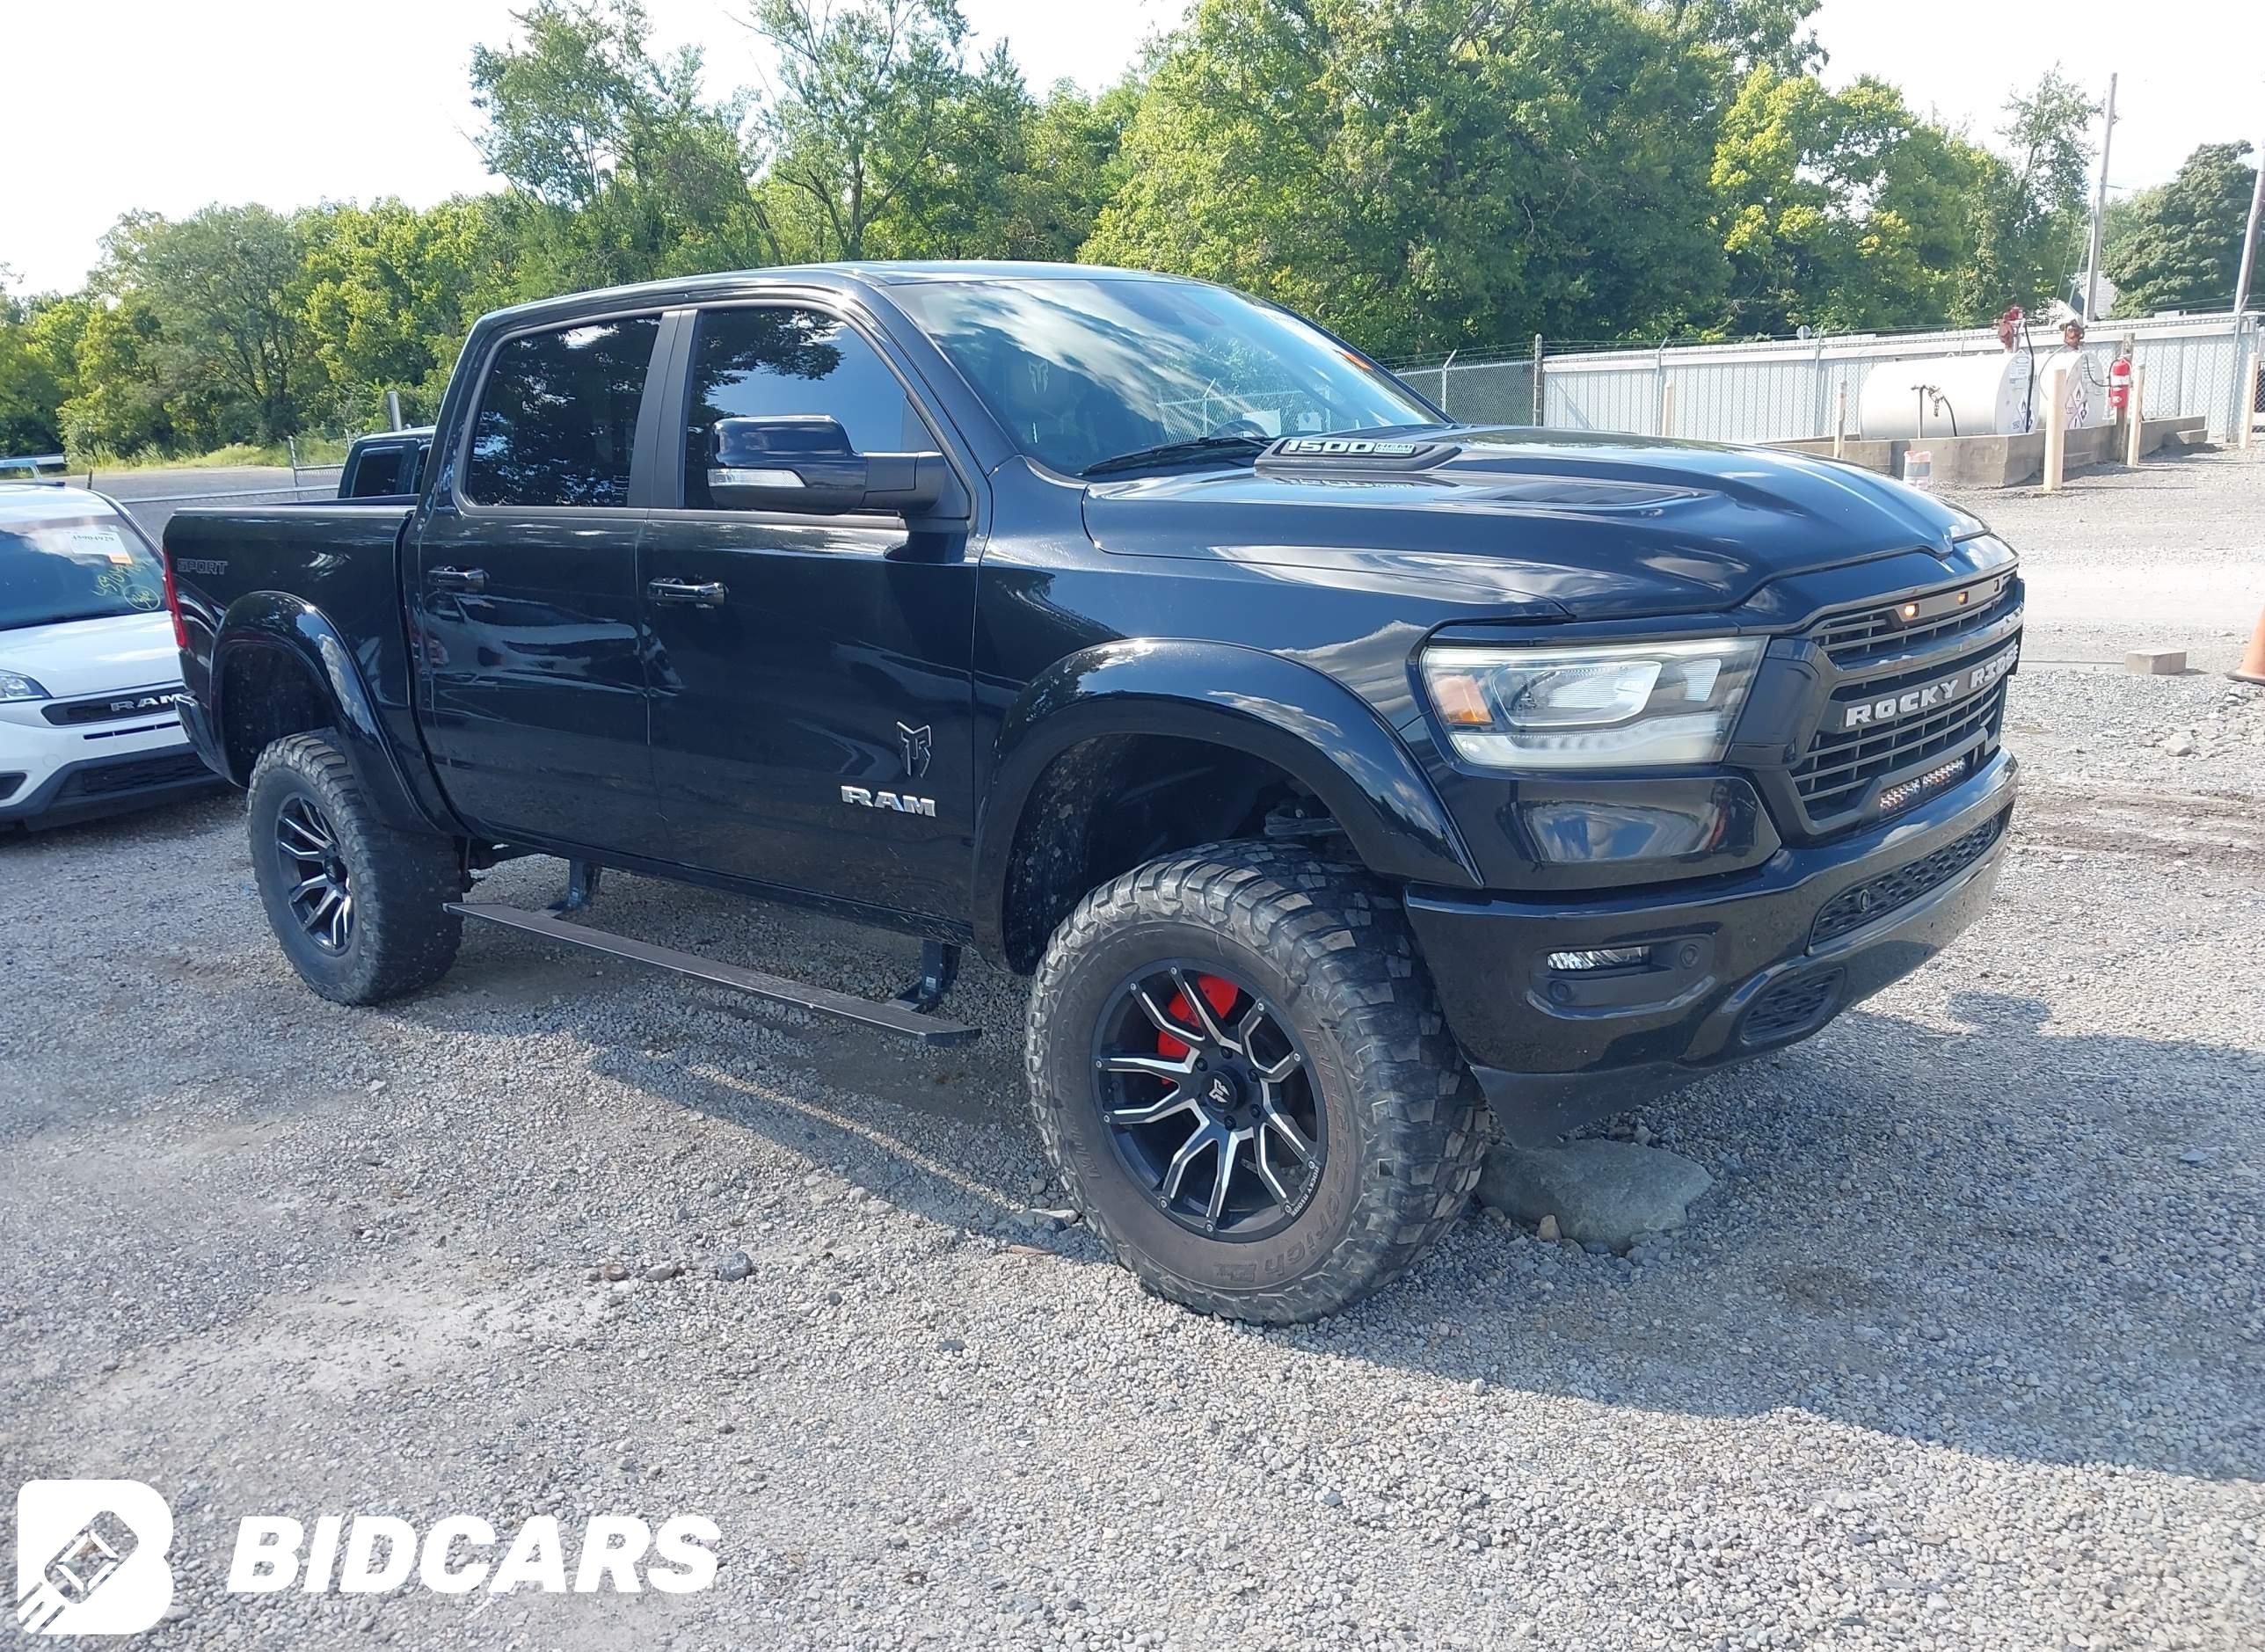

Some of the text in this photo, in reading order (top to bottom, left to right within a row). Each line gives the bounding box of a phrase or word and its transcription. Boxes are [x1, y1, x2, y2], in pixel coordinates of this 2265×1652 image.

[1286, 440, 1376, 454] 1500
[177, 558, 229, 575] SPORT
[1846, 644, 2019, 728] ROCKY RIDGE
[110, 693, 184, 712] RAM
[841, 785, 936, 818] RAM
[1307, 1166, 1320, 1195] ROCKY
